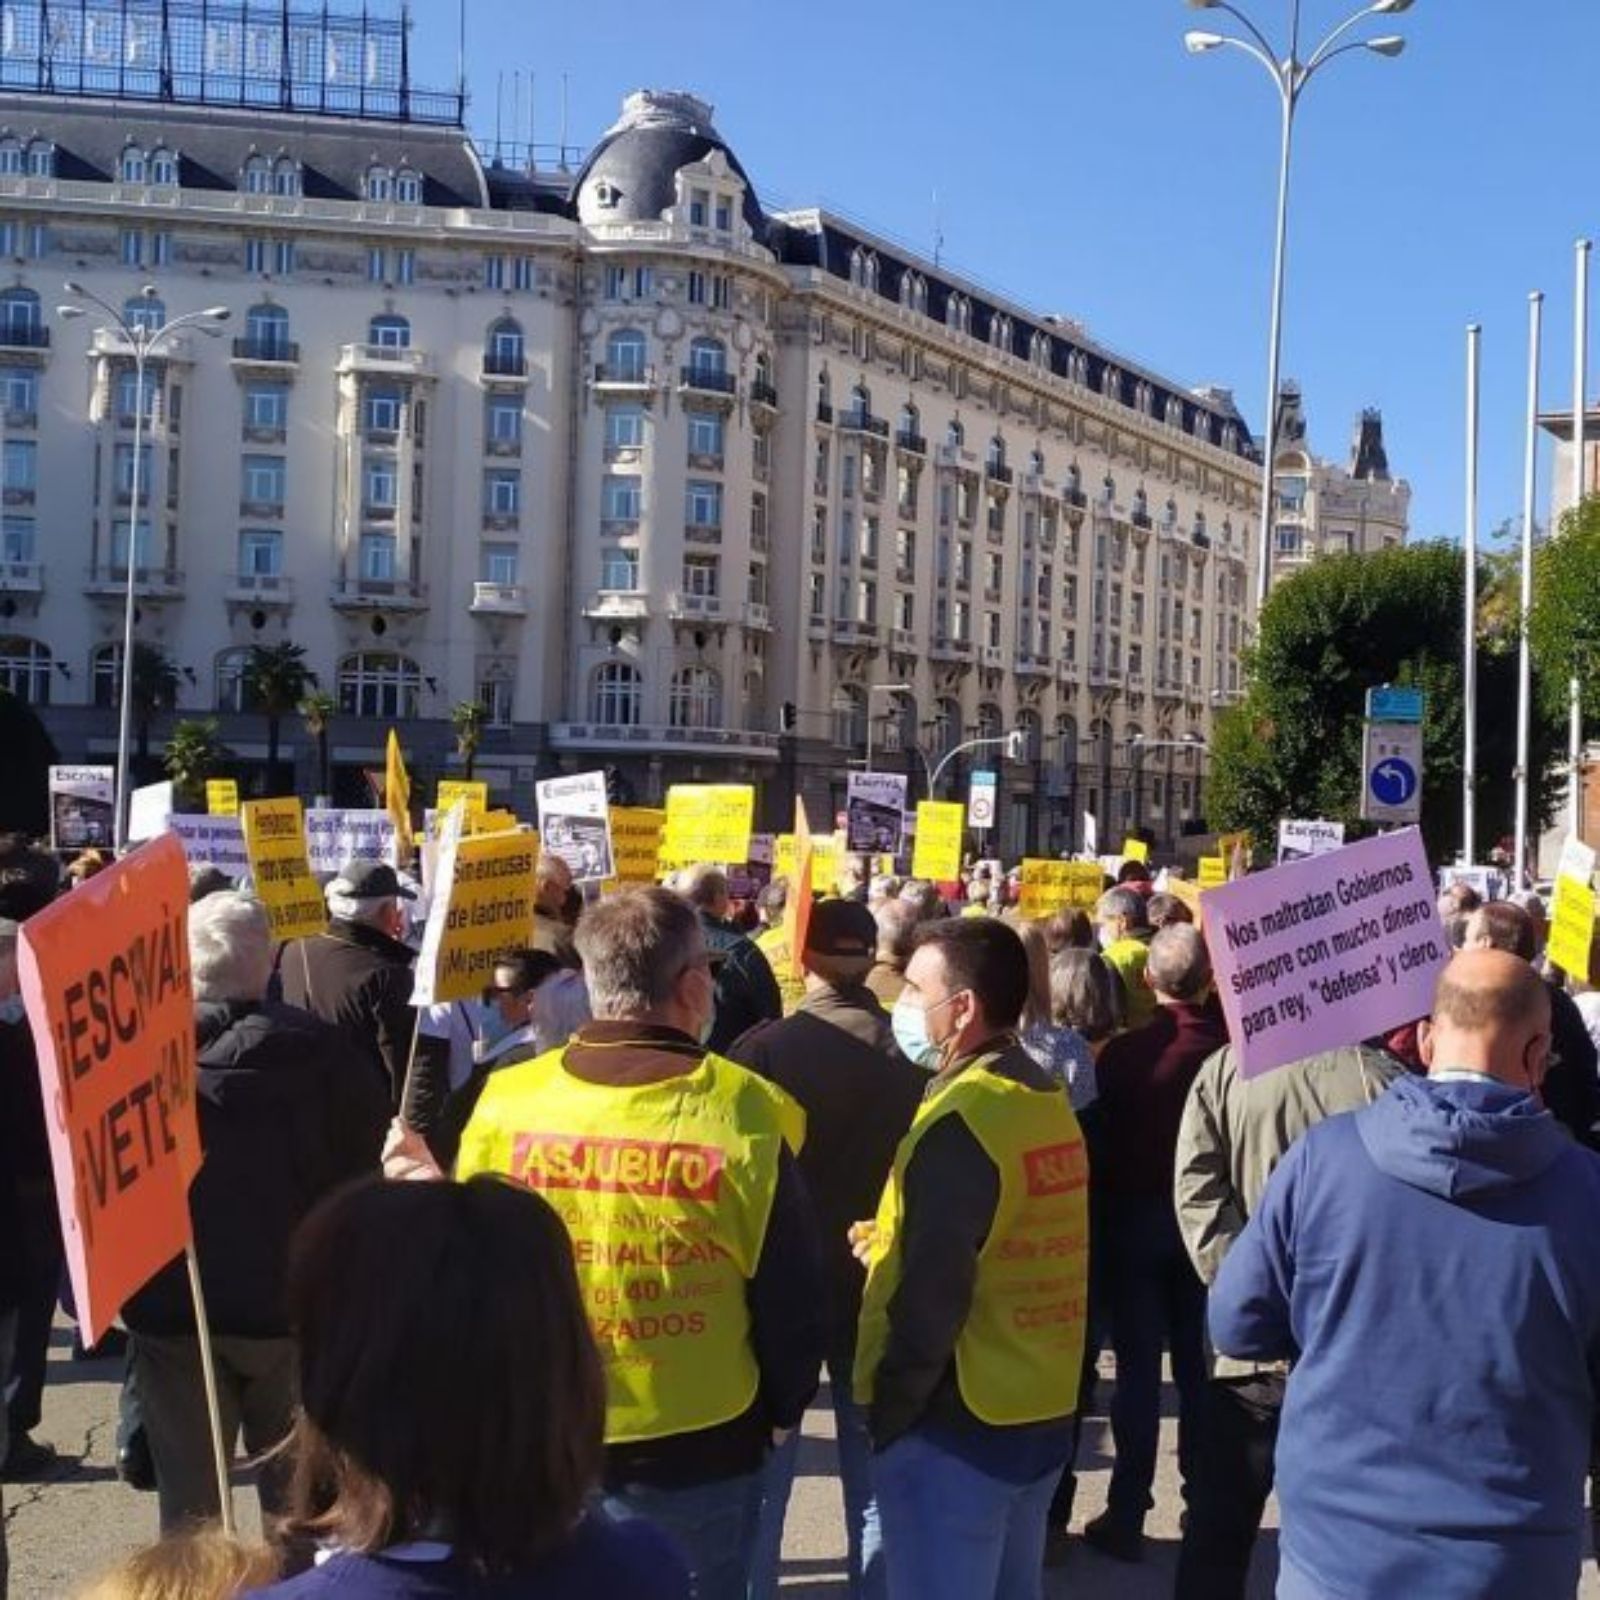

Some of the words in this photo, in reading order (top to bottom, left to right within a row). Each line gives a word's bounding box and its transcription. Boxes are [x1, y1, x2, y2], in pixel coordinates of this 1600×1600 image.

[475, 852, 531, 880] excusas
[1225, 918, 1258, 949] Nos
[1260, 891, 1338, 936] maltratan
[1337, 862, 1413, 906] Gobiernos
[447, 904, 468, 930] de
[1231, 953, 1294, 994] siempre
[1297, 940, 1330, 967] con
[1332, 918, 1381, 955] mucho
[1383, 900, 1431, 933] dinero
[1241, 1006, 1277, 1043] para
[1279, 994, 1312, 1022] rey,
[1386, 956, 1397, 984] y
[1399, 940, 1443, 971] clero.
